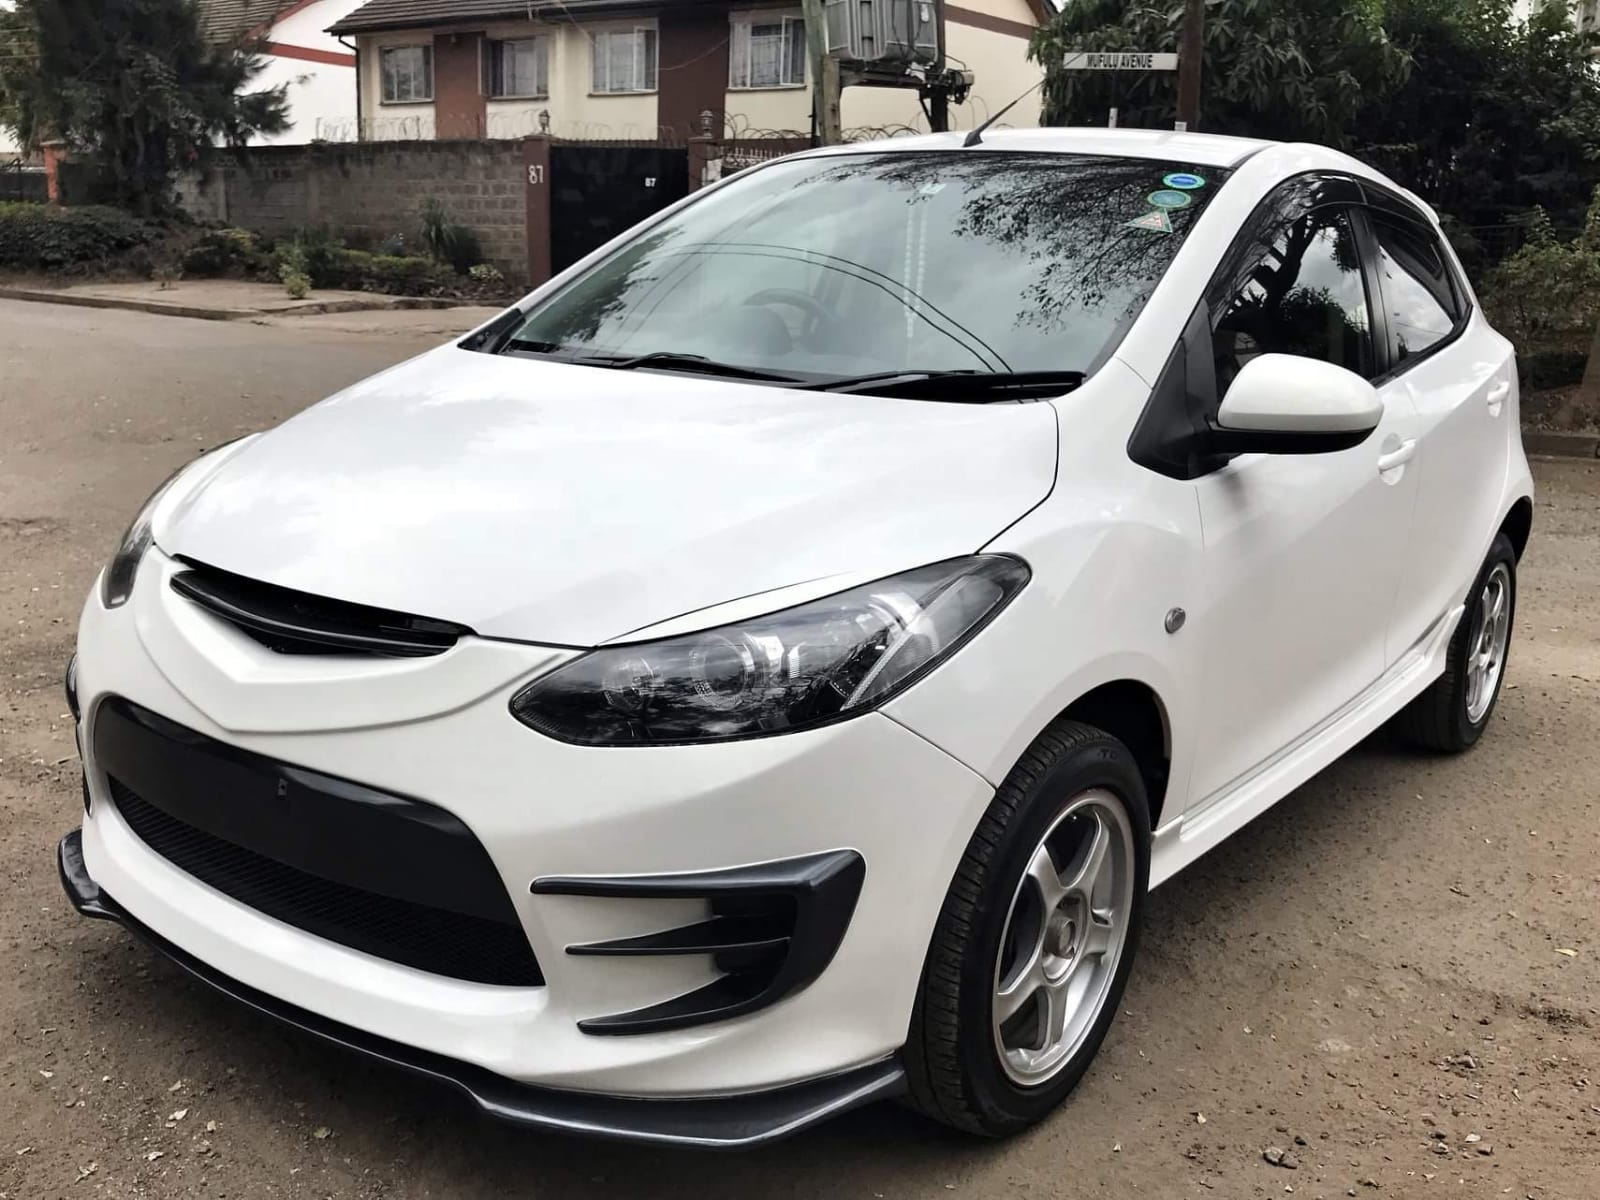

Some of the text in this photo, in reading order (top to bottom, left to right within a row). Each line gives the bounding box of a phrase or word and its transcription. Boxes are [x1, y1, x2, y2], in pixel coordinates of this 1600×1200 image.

[1121, 54, 1153, 68] AVENUE
[528, 164, 544, 185] 87
[645, 177, 657, 188] 87
